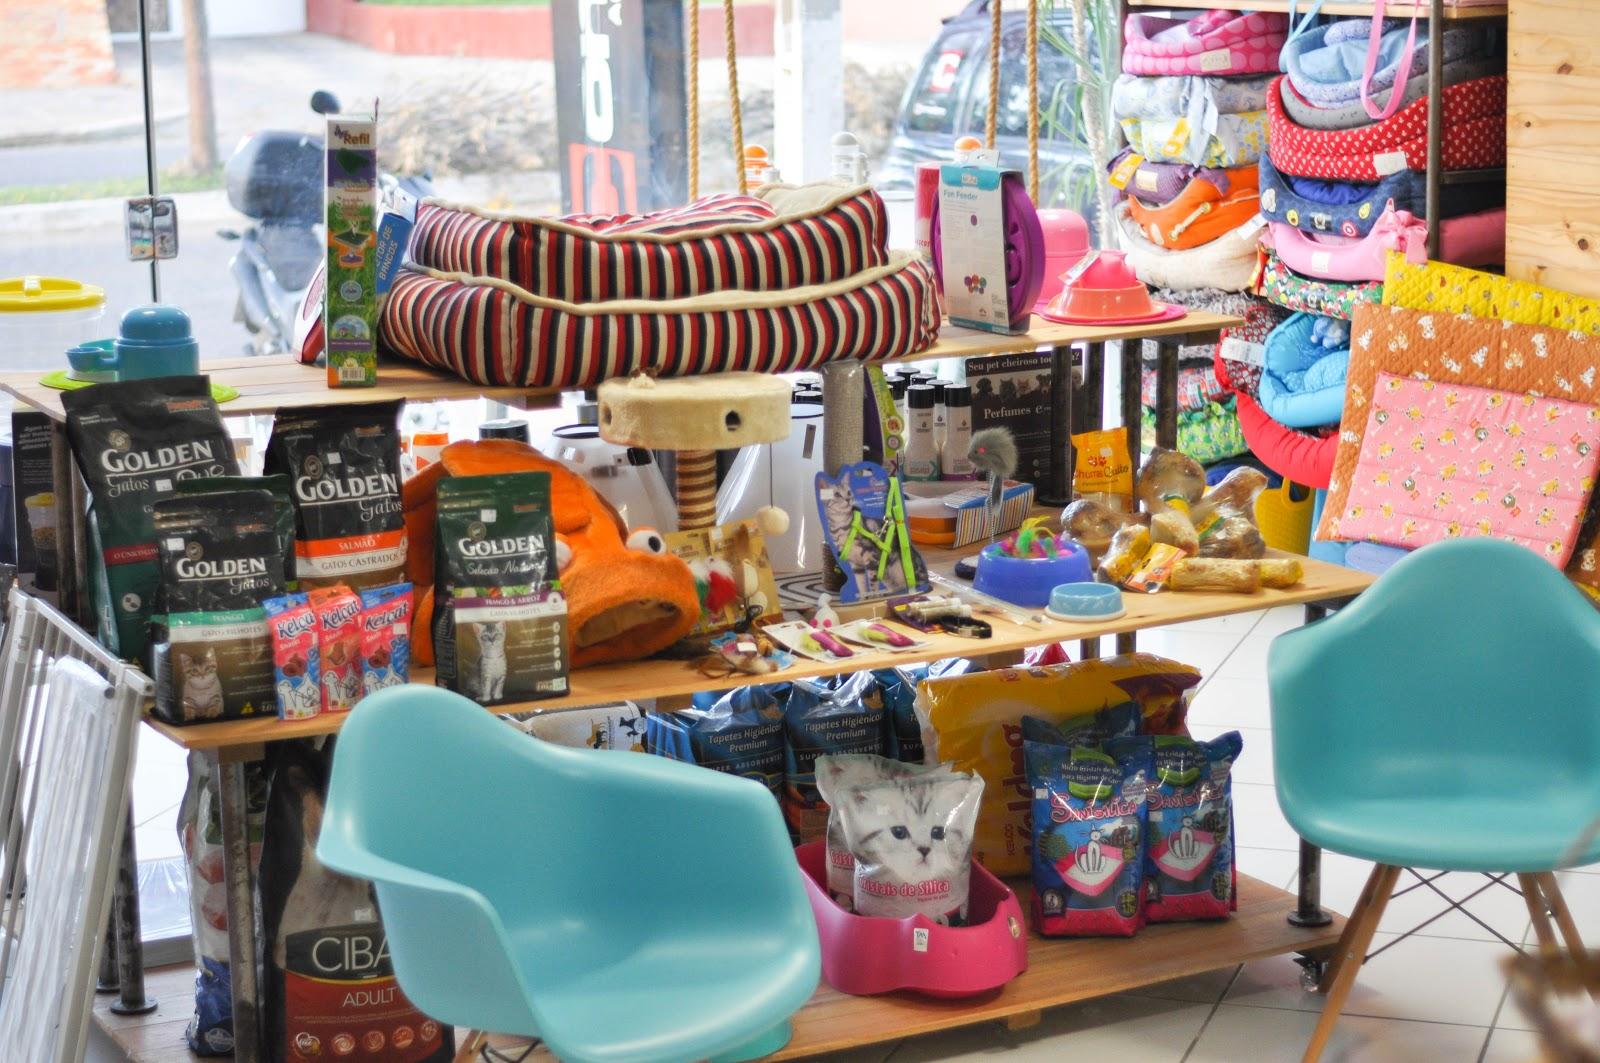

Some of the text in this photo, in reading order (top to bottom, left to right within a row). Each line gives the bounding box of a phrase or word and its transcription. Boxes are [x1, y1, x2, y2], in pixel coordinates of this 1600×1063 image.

[343, 132, 370, 145] Refil
[986, 359, 1000, 373] pet
[1001, 356, 1038, 368] cheiroso
[984, 406, 1031, 419] Perfumes
[101, 440, 213, 472] GOLDEN
[296, 473, 398, 501] GOLDEN
[458, 534, 546, 556] GOLDEN
[175, 557, 267, 579] GOLDEN
[321, 599, 360, 630] Kelcat
[364, 602, 408, 631] Kelcat
[804, 720, 840, 733] Tapetes
[708, 731, 743, 745] Tapetes
[826, 728, 866, 741] Premium
[729, 739, 767, 753] Premium
[900, 882, 916, 896] de
